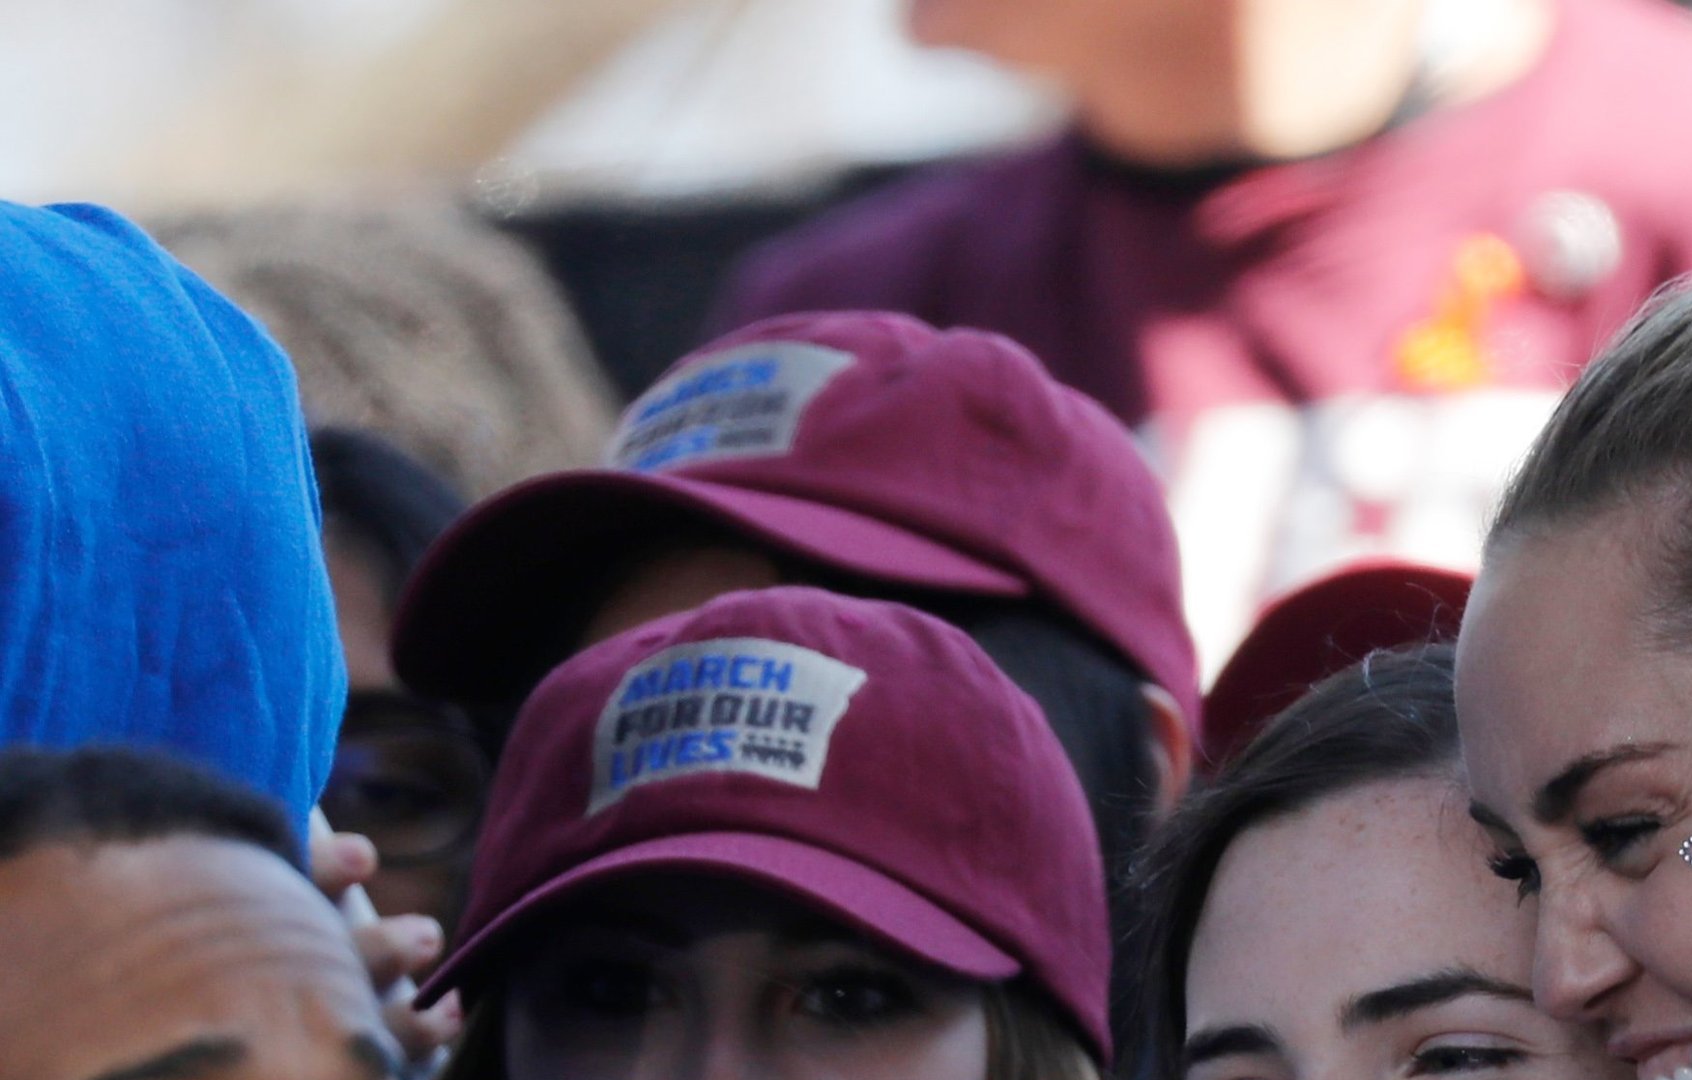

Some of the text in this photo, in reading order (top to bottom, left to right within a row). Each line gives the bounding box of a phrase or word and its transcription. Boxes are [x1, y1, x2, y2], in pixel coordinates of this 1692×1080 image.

[621, 655, 793, 706] MARCH
[613, 693, 815, 746] FOR OUR
[610, 730, 736, 789] LIVES
